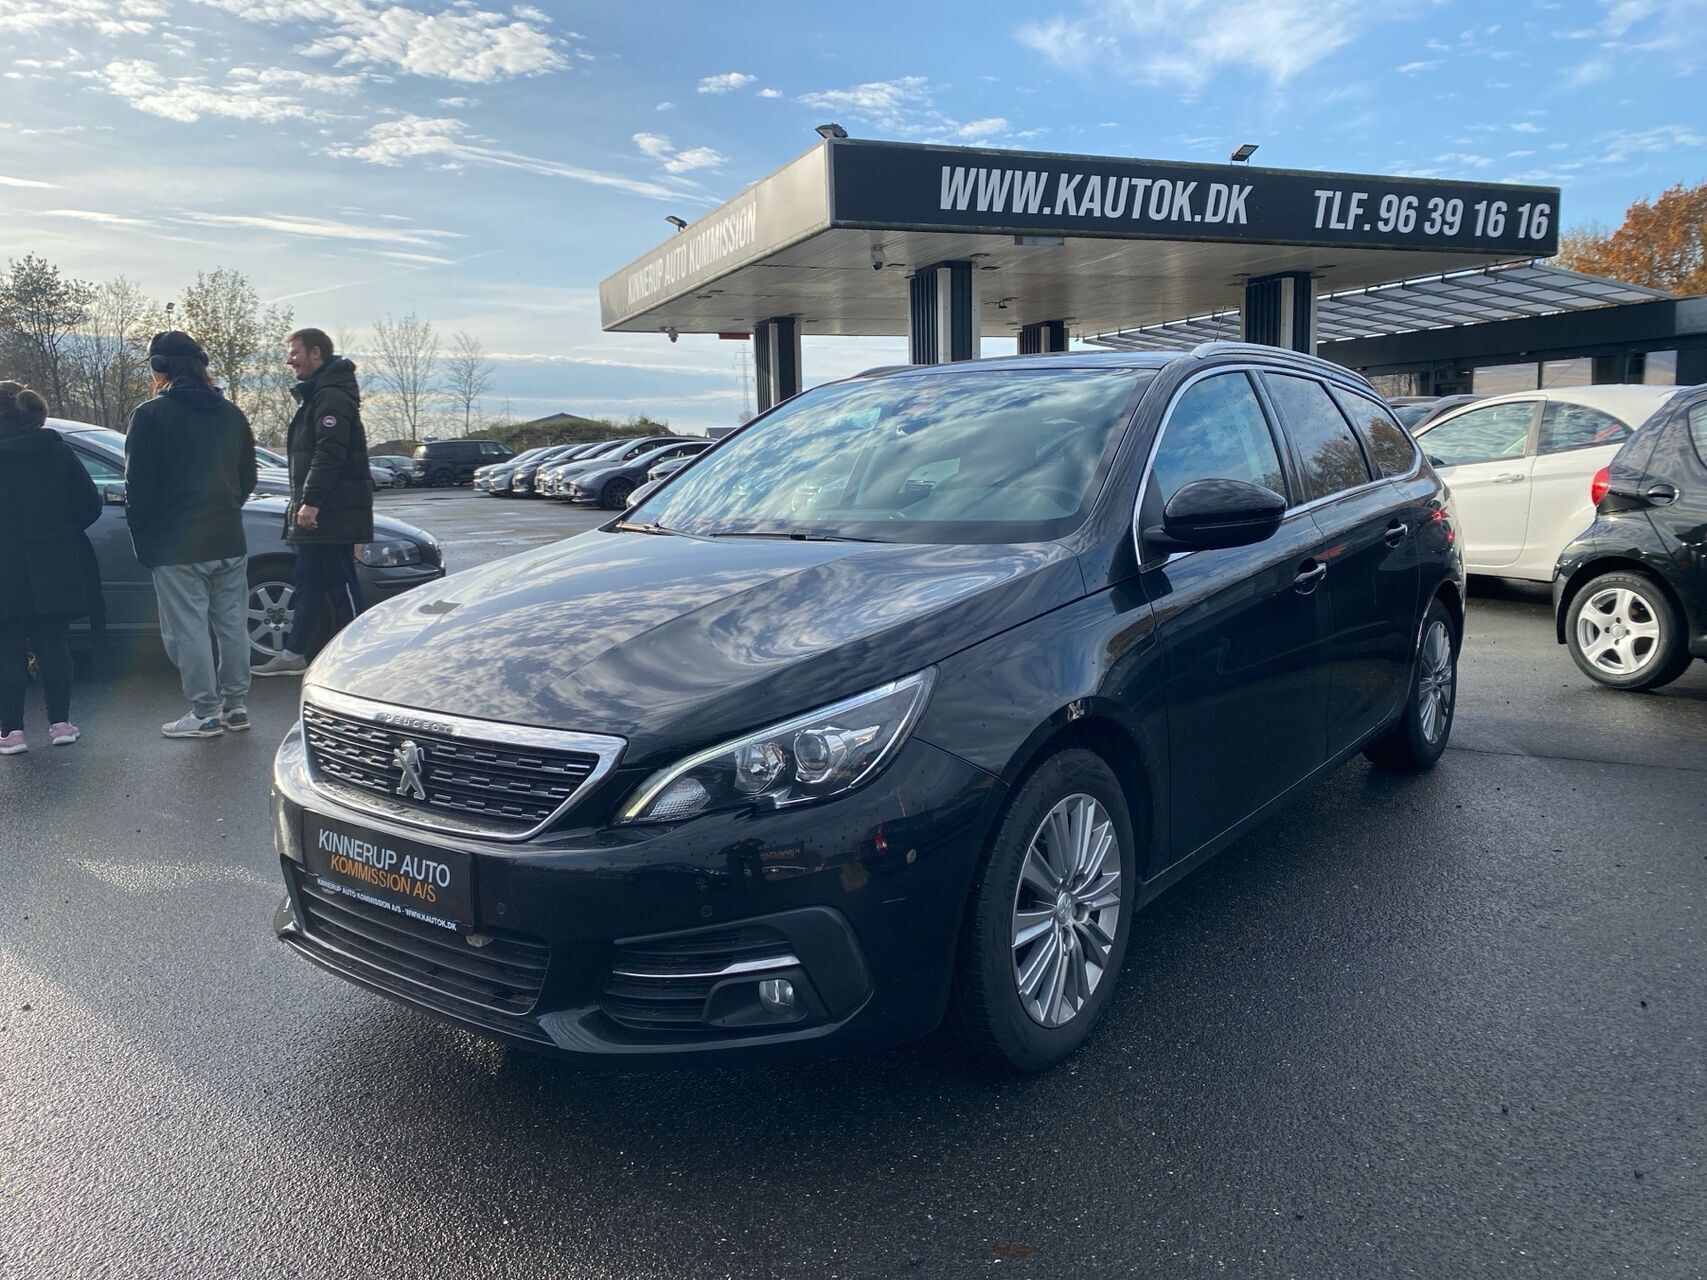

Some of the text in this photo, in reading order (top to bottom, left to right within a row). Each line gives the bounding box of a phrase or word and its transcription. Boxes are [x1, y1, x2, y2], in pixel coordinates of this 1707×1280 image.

[940, 165, 1551, 240] WWW.KAUTOK.DK TLF. 96 39 16 16
[628, 201, 757, 305] KINNERUP AUTO KOMMISSION
[385, 713, 450, 734] PEUGEOT
[318, 828, 450, 887] KINNERUP AUTO
[330, 854, 436, 903] KOMMISSION A/S
[317, 878, 342, 892] KINNERUP
[342, 887, 357, 898] AUTO
[356, 892, 391, 909] KOMMISSION
